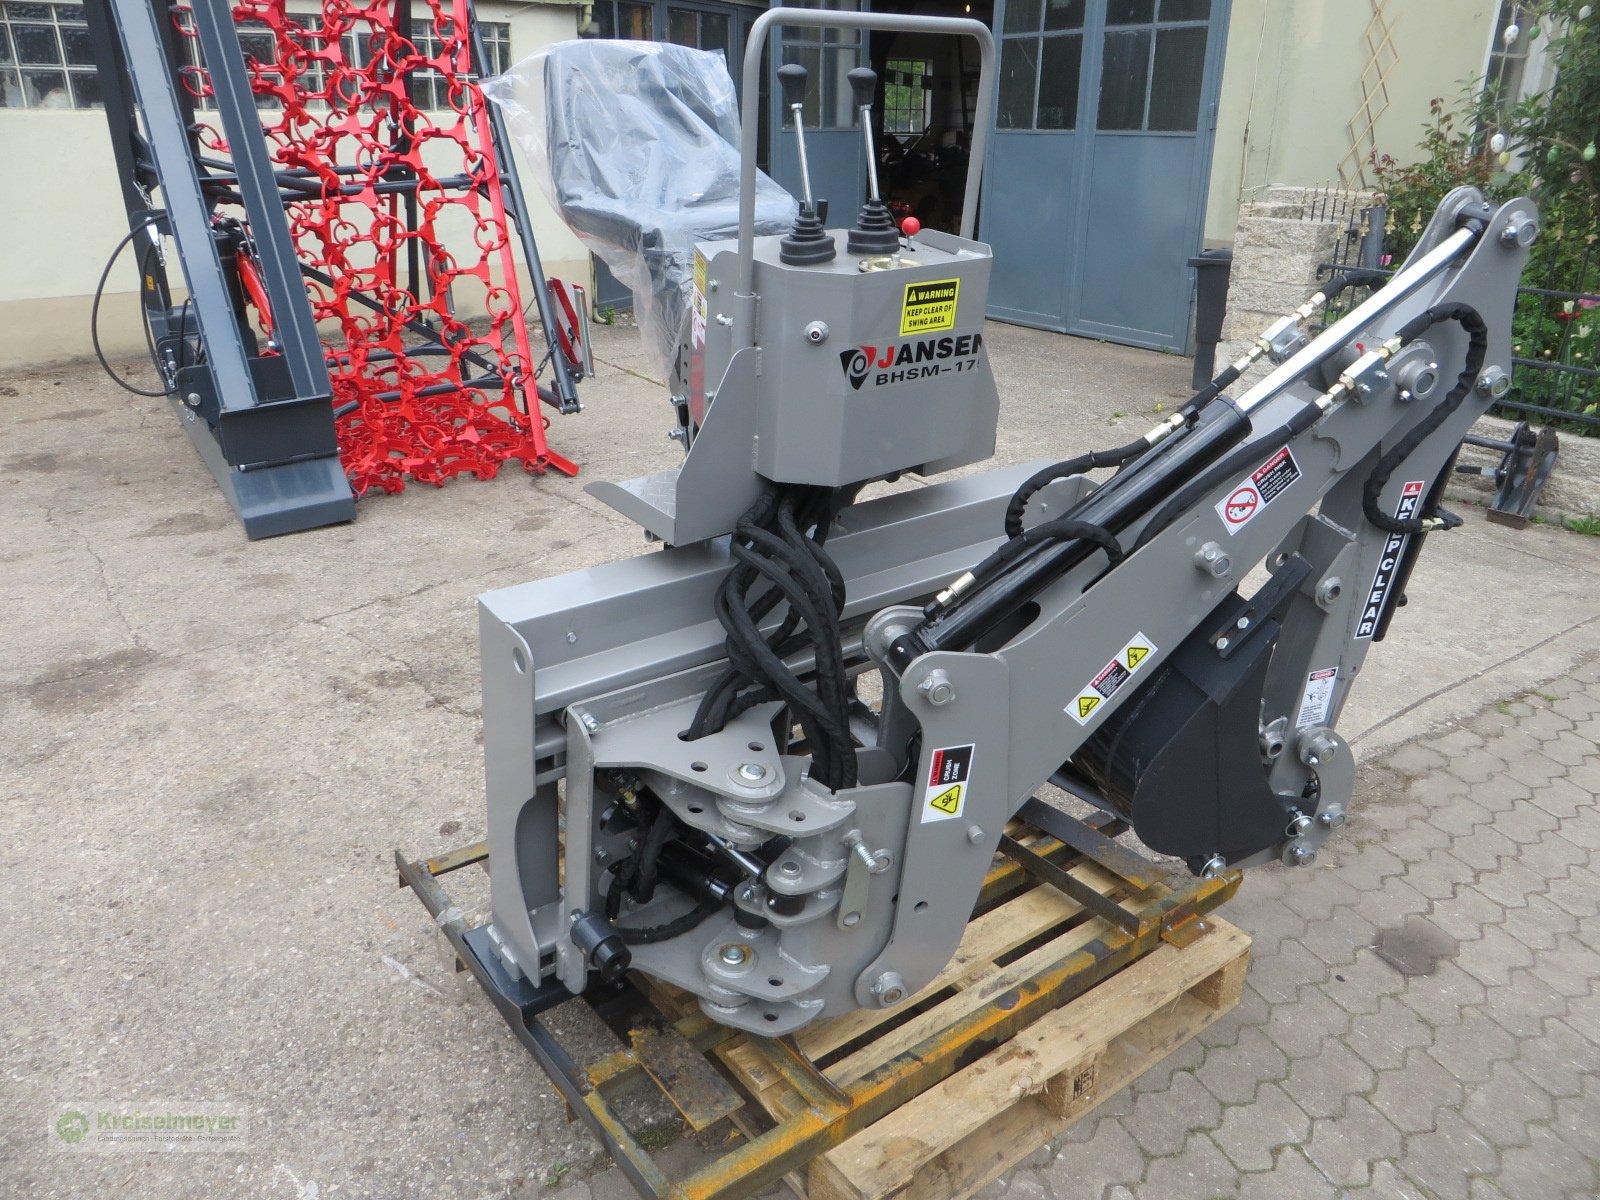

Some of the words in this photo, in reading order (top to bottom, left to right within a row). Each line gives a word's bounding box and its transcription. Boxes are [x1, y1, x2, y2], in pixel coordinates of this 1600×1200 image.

[918, 288, 955, 301] WARNING
[907, 308, 922, 317] KEEP
[923, 305, 943, 315] CLEAR
[944, 304, 952, 312] OF
[908, 318, 928, 328] SWING
[929, 316, 945, 324] AREA
[875, 359, 980, 386] BHSM-17
[1262, 452, 1285, 472] DANGER
[1359, 558, 1394, 635] CLEAR
[943, 759, 953, 781] CRUSH
[951, 762, 961, 780] ZONE
